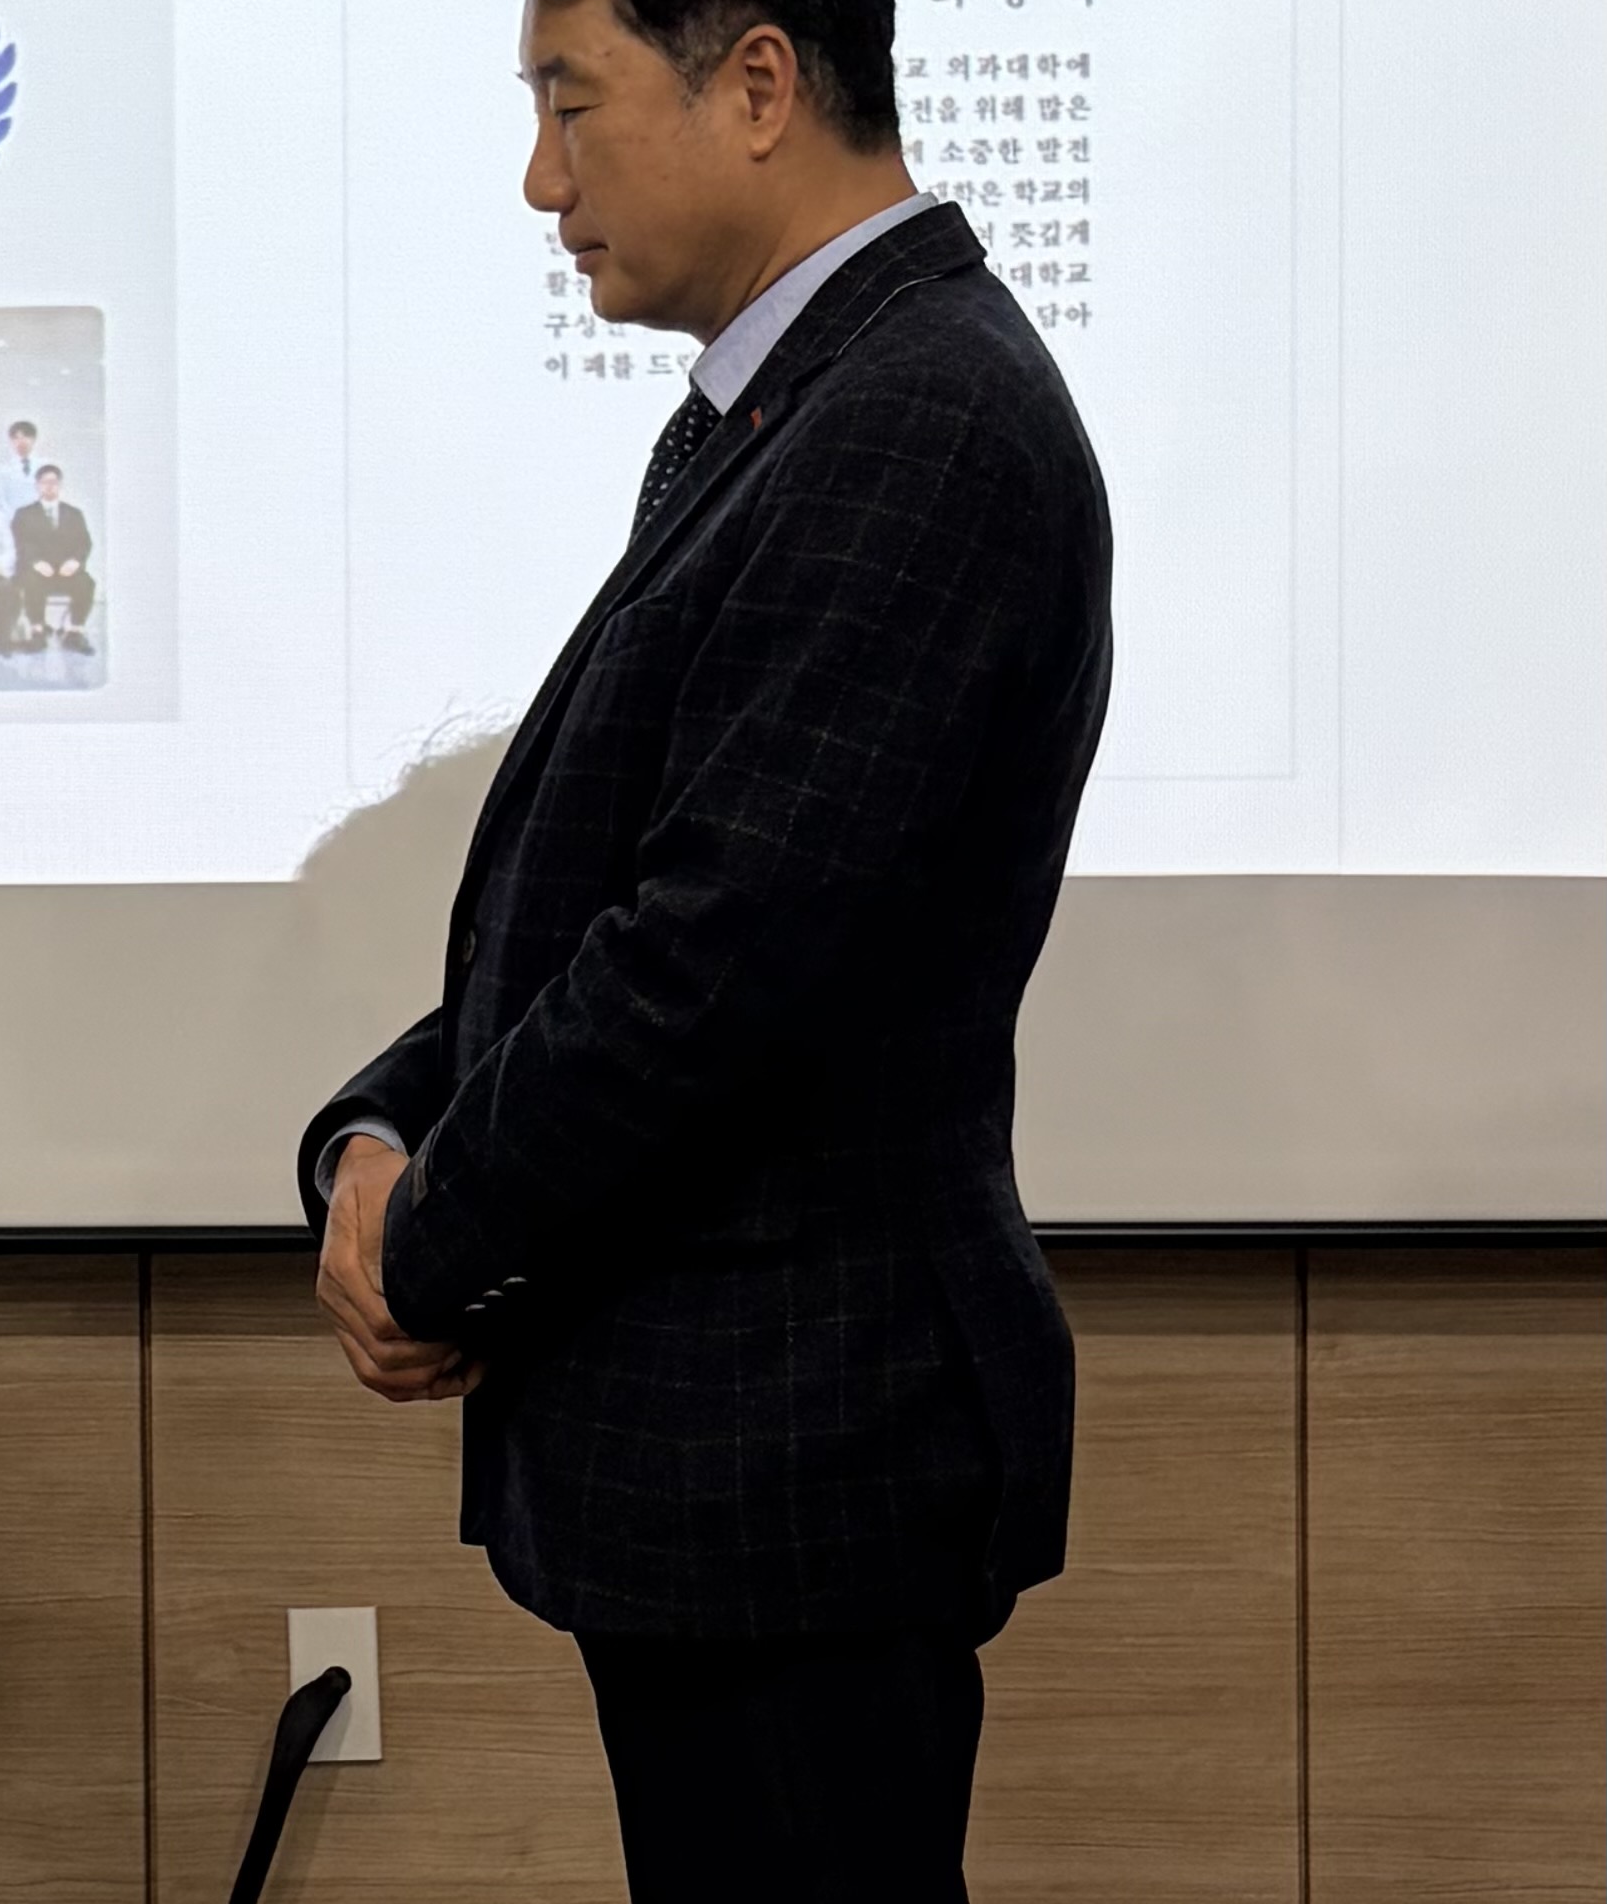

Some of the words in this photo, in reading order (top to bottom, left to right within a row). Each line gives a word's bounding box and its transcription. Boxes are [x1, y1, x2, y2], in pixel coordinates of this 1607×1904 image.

[974, 95, 1026, 123] 위해
[1037, 95, 1092, 122] 많은
[939, 138, 1023, 165] 소중한
[1036, 136, 1092, 164] 발전
[1012, 177, 1091, 205] 학교의
[1036, 302, 1093, 329] 담아
[544, 352, 568, 381] 이
